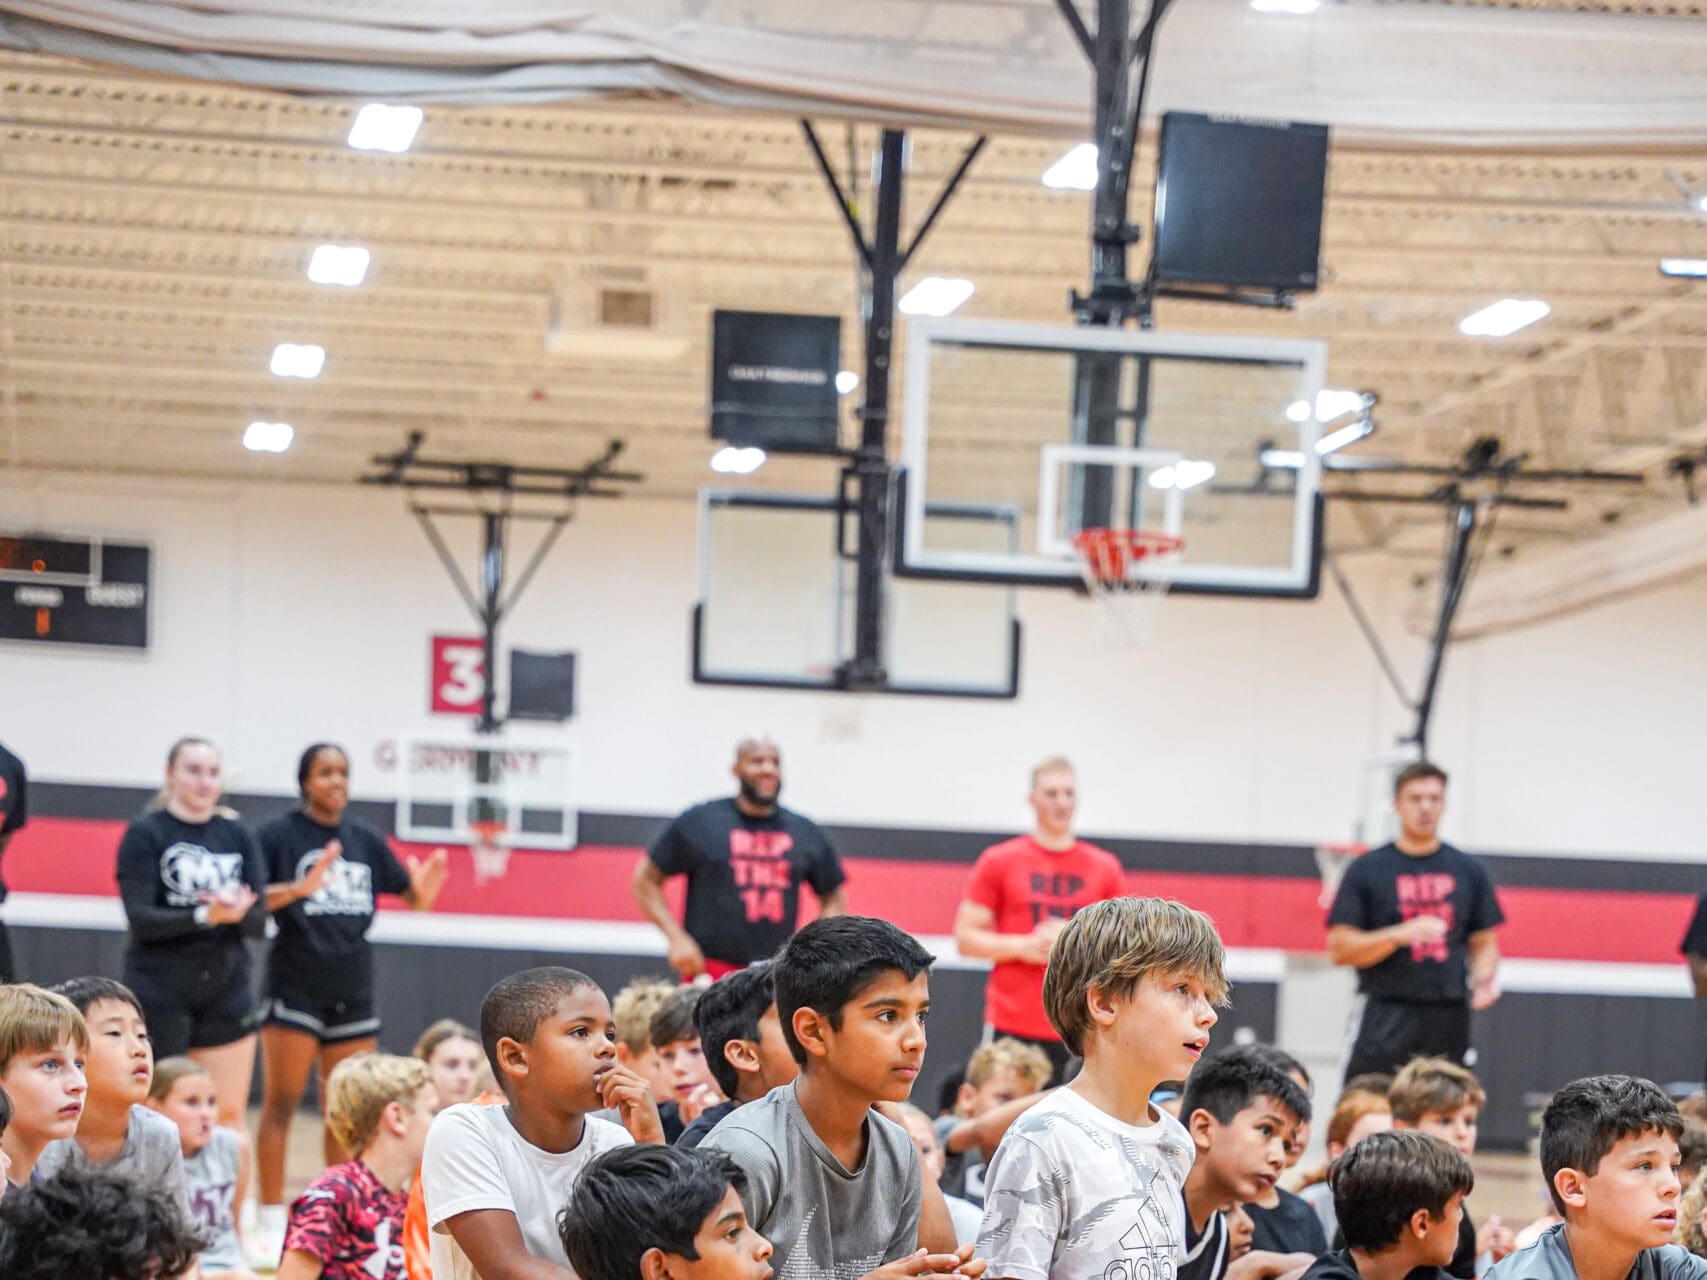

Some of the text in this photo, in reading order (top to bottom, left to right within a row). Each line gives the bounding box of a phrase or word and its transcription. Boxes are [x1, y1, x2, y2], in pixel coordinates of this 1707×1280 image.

[440, 645, 485, 706] 3
[730, 828, 793, 857] REP
[730, 858, 791, 889] THE
[1030, 872, 1085, 896] REP
[1396, 873, 1456, 901] REP
[740, 888, 785, 923] 14
